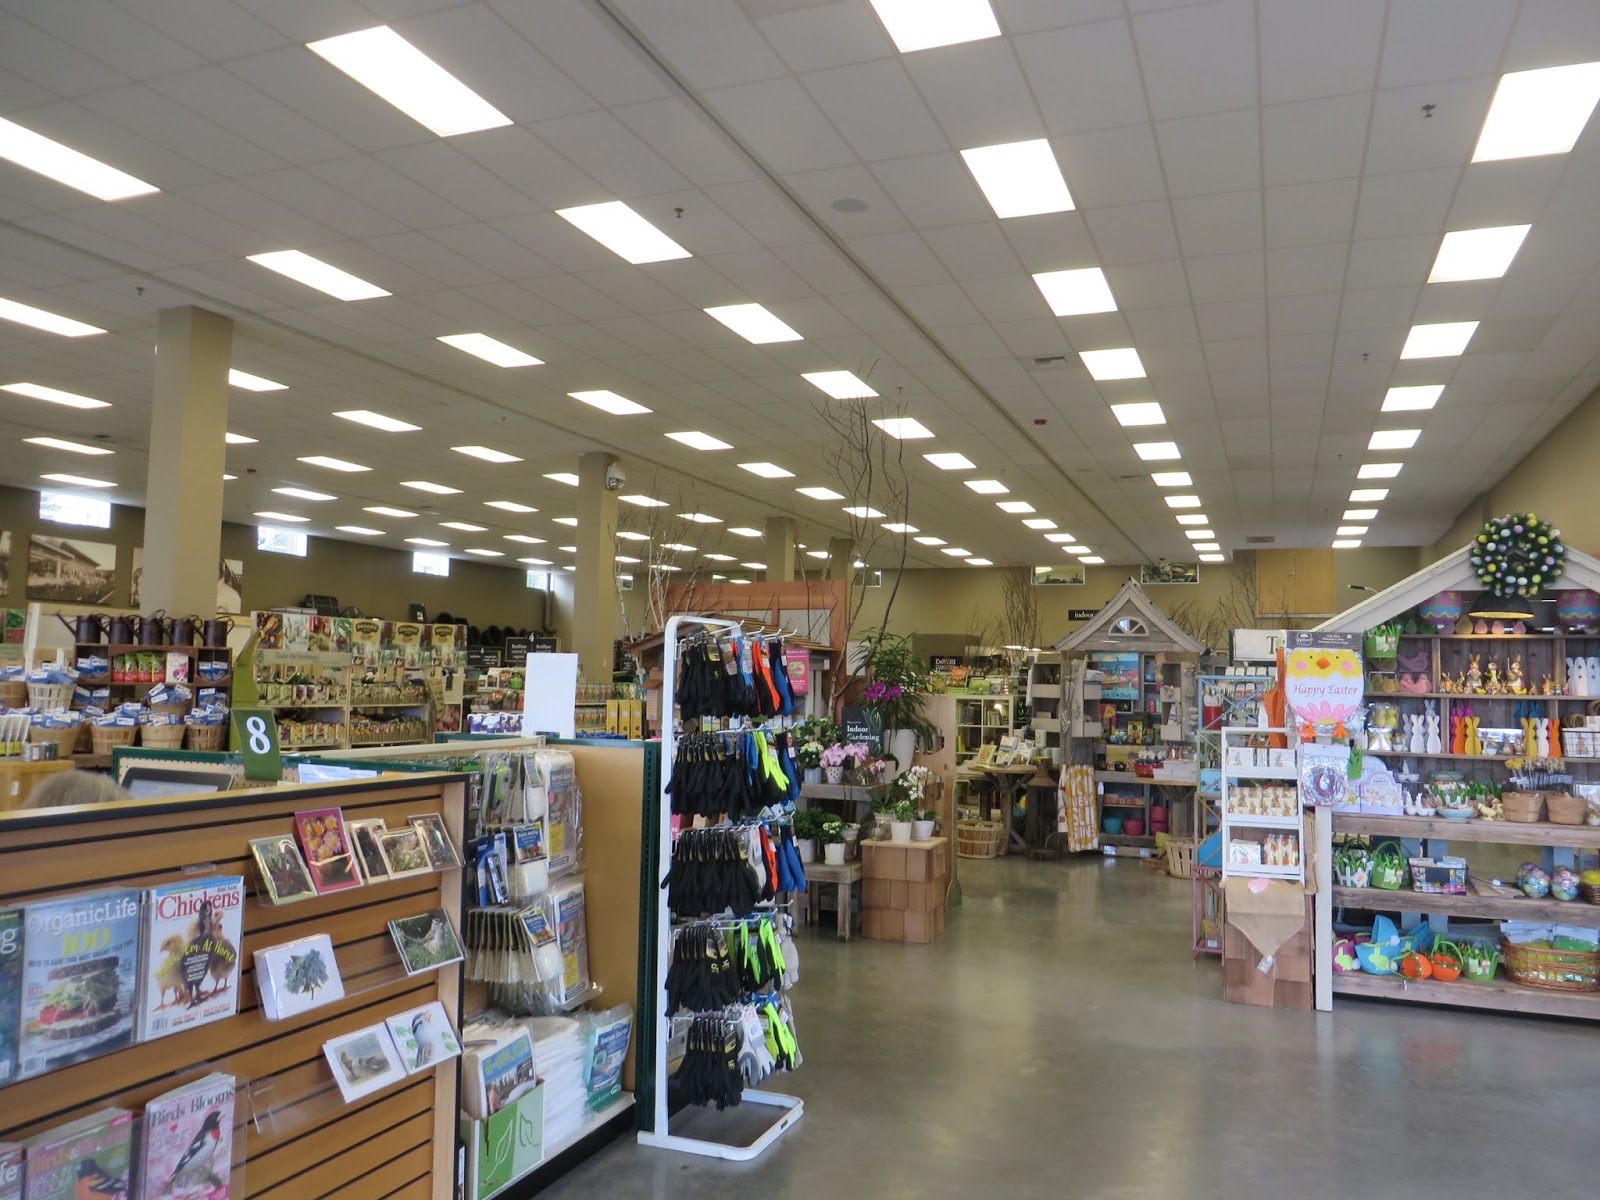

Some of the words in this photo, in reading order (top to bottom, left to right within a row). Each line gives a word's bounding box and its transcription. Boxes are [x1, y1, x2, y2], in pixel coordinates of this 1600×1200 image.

[528, 632, 535, 642] 4
[1292, 684, 1326, 697] Happy
[1328, 684, 1358, 695] Easter
[246, 716, 270, 754] 8
[29, 898, 137, 936] OrganicLife
[158, 890, 240, 919] Chickens
[63, 925, 111, 957] 100
[150, 1103, 186, 1127] Birds
[190, 1089, 236, 1113] Blooms
